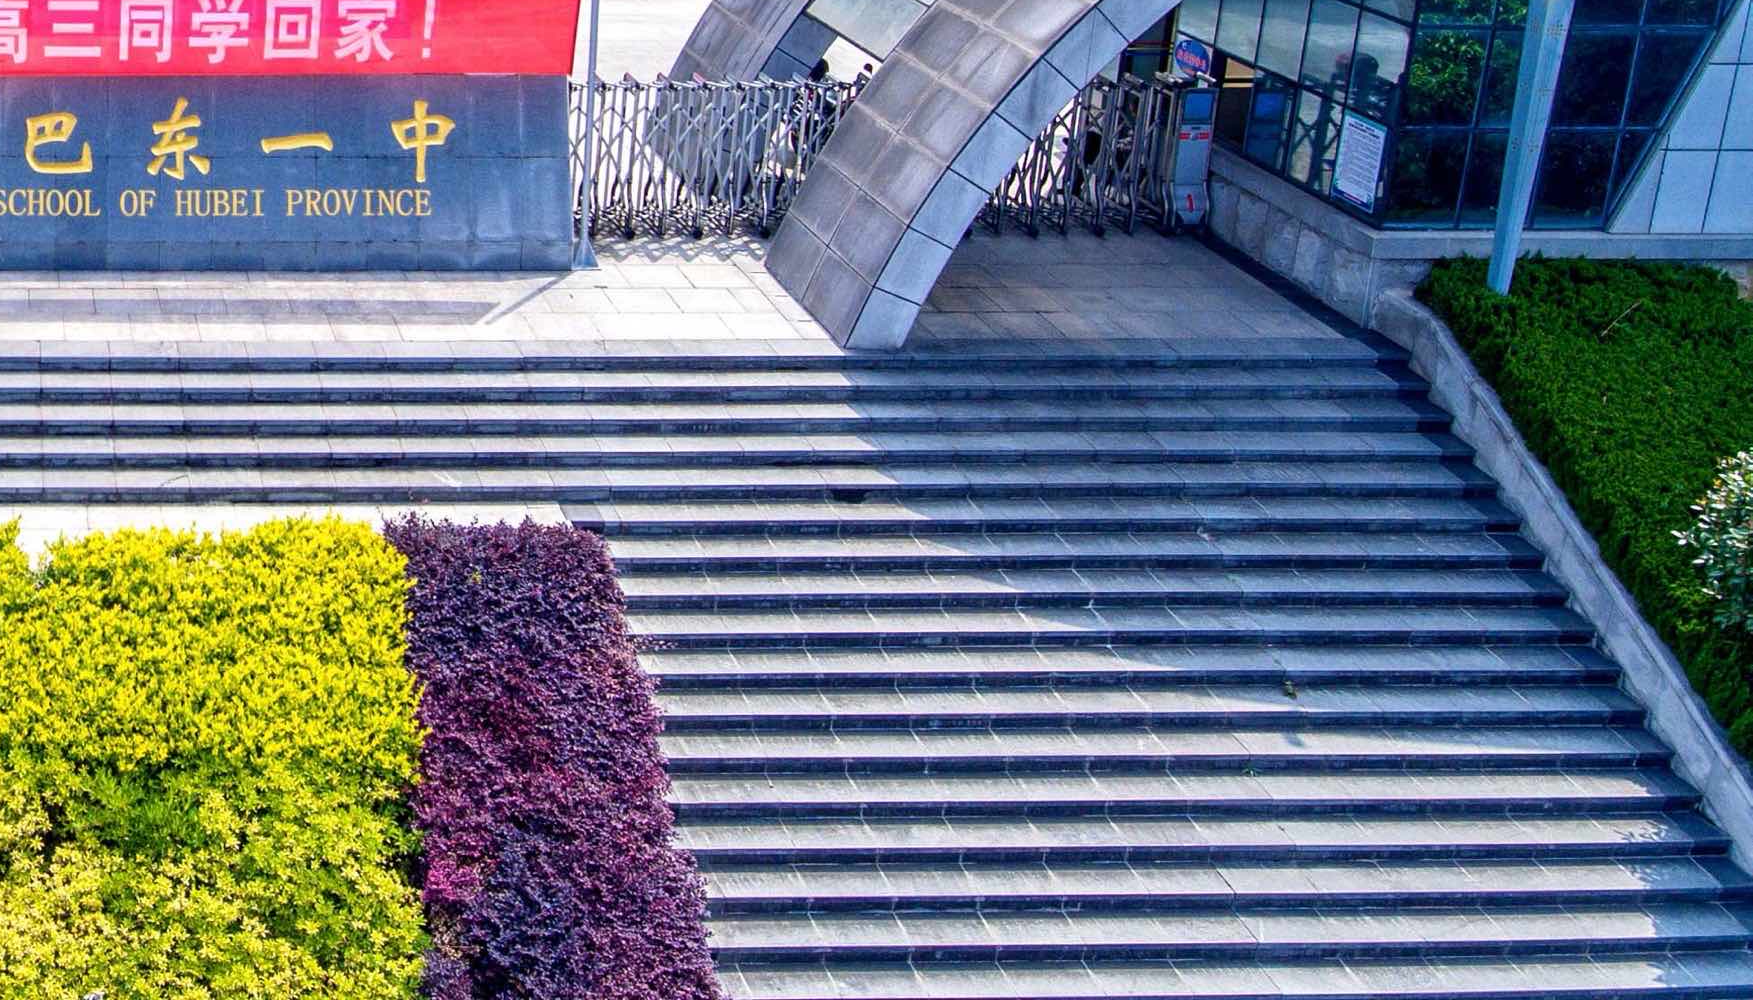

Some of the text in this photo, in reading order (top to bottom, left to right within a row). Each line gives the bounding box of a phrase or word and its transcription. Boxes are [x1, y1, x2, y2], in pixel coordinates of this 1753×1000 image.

[119, 190, 156, 217] OF
[175, 190, 265, 217] HUBEI
[286, 190, 432, 217] PROVINCE
